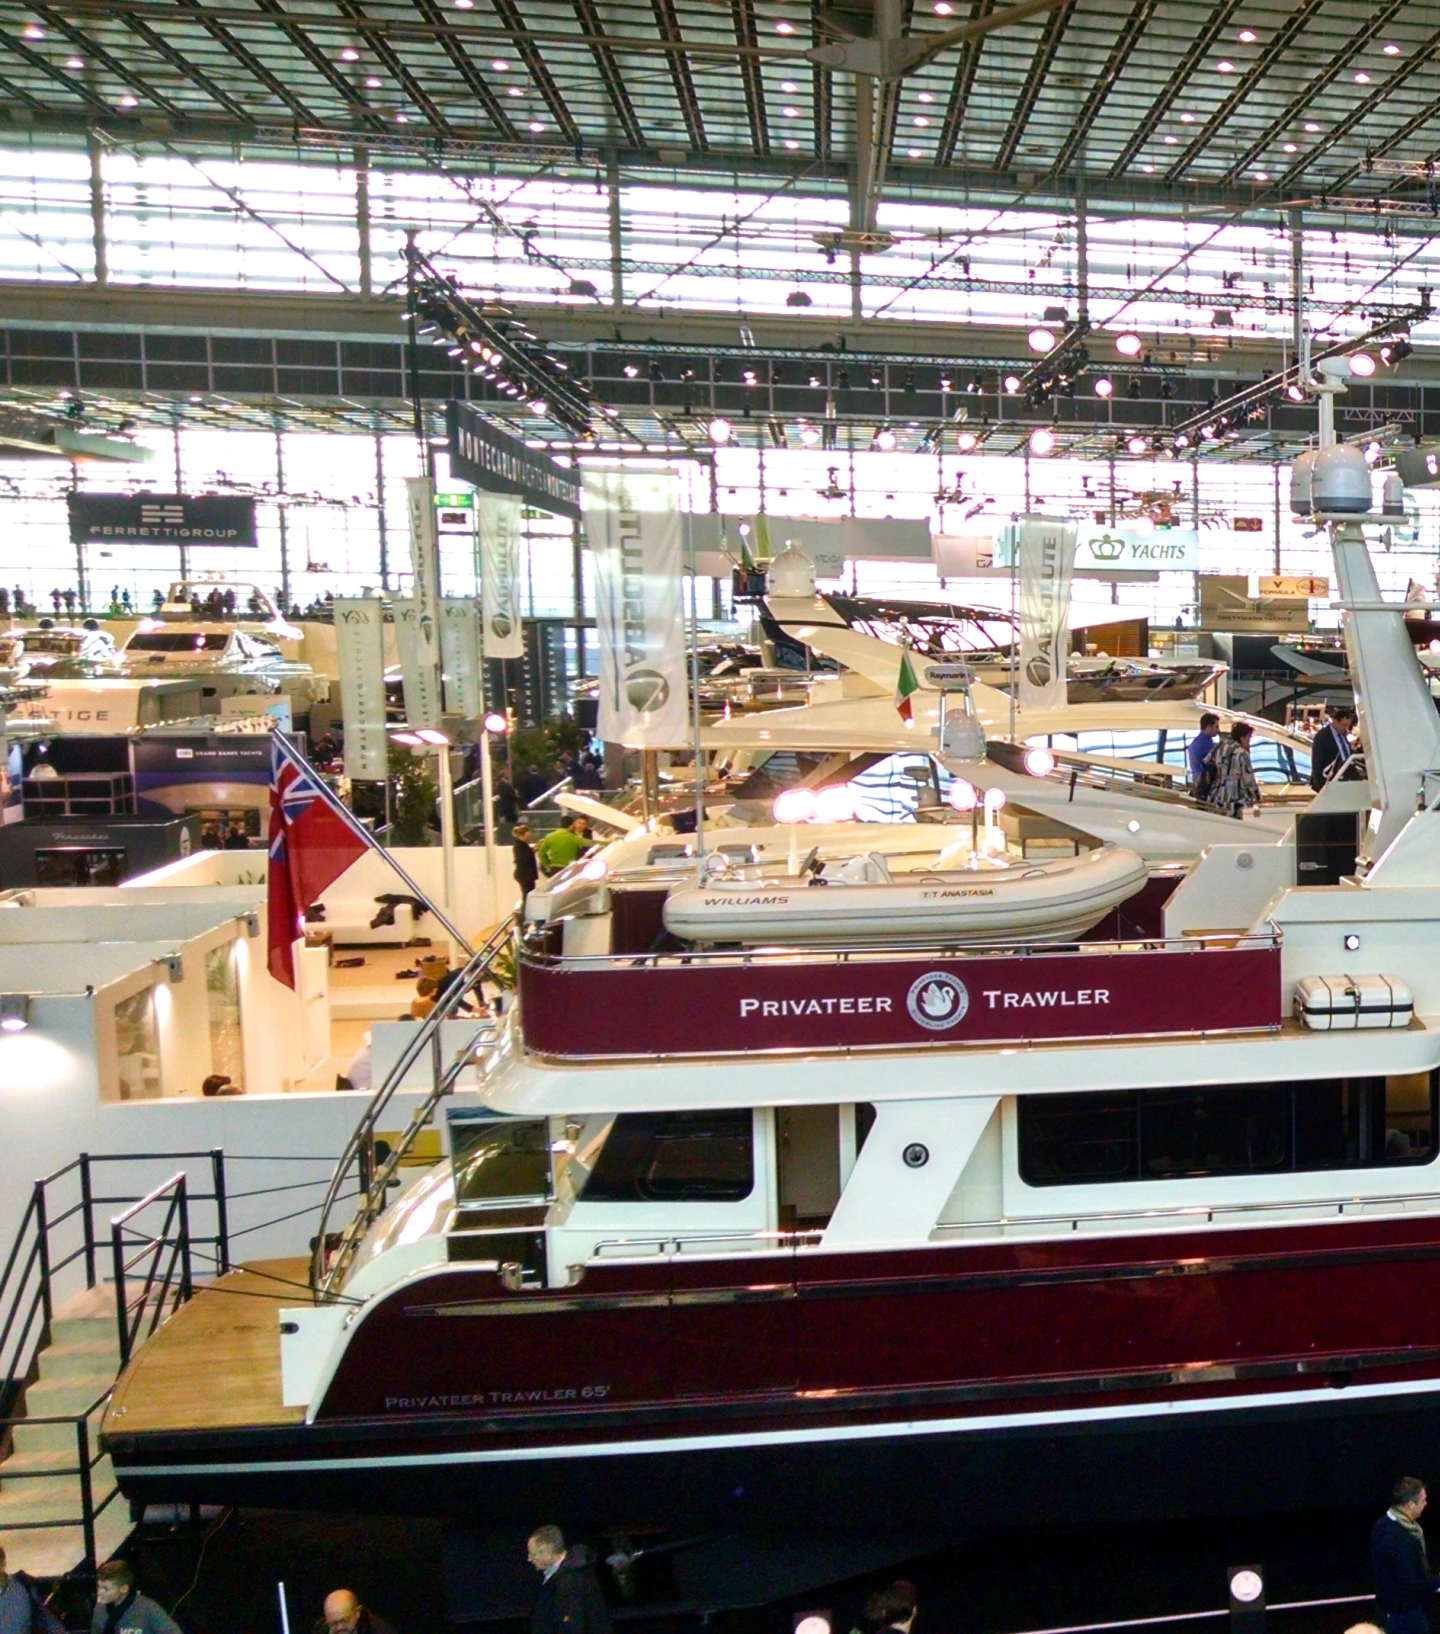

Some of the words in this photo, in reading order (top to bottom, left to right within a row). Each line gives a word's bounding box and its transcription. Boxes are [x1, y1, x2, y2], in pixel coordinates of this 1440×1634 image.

[89, 526, 238, 538] FERRETTIGROUP
[1131, 544, 1186, 559] YACHTS
[1038, 536, 1057, 656] ABSOLUTE
[704, 896, 789, 906] WILLIAMS
[940, 889, 994, 898] ANASTASIA
[740, 997, 892, 1018] PRIVATEER
[983, 988, 1111, 1009] TRAWLER
[385, 1394, 485, 1409] PRIVATEER
[488, 1388, 577, 1404] TRAWLER
